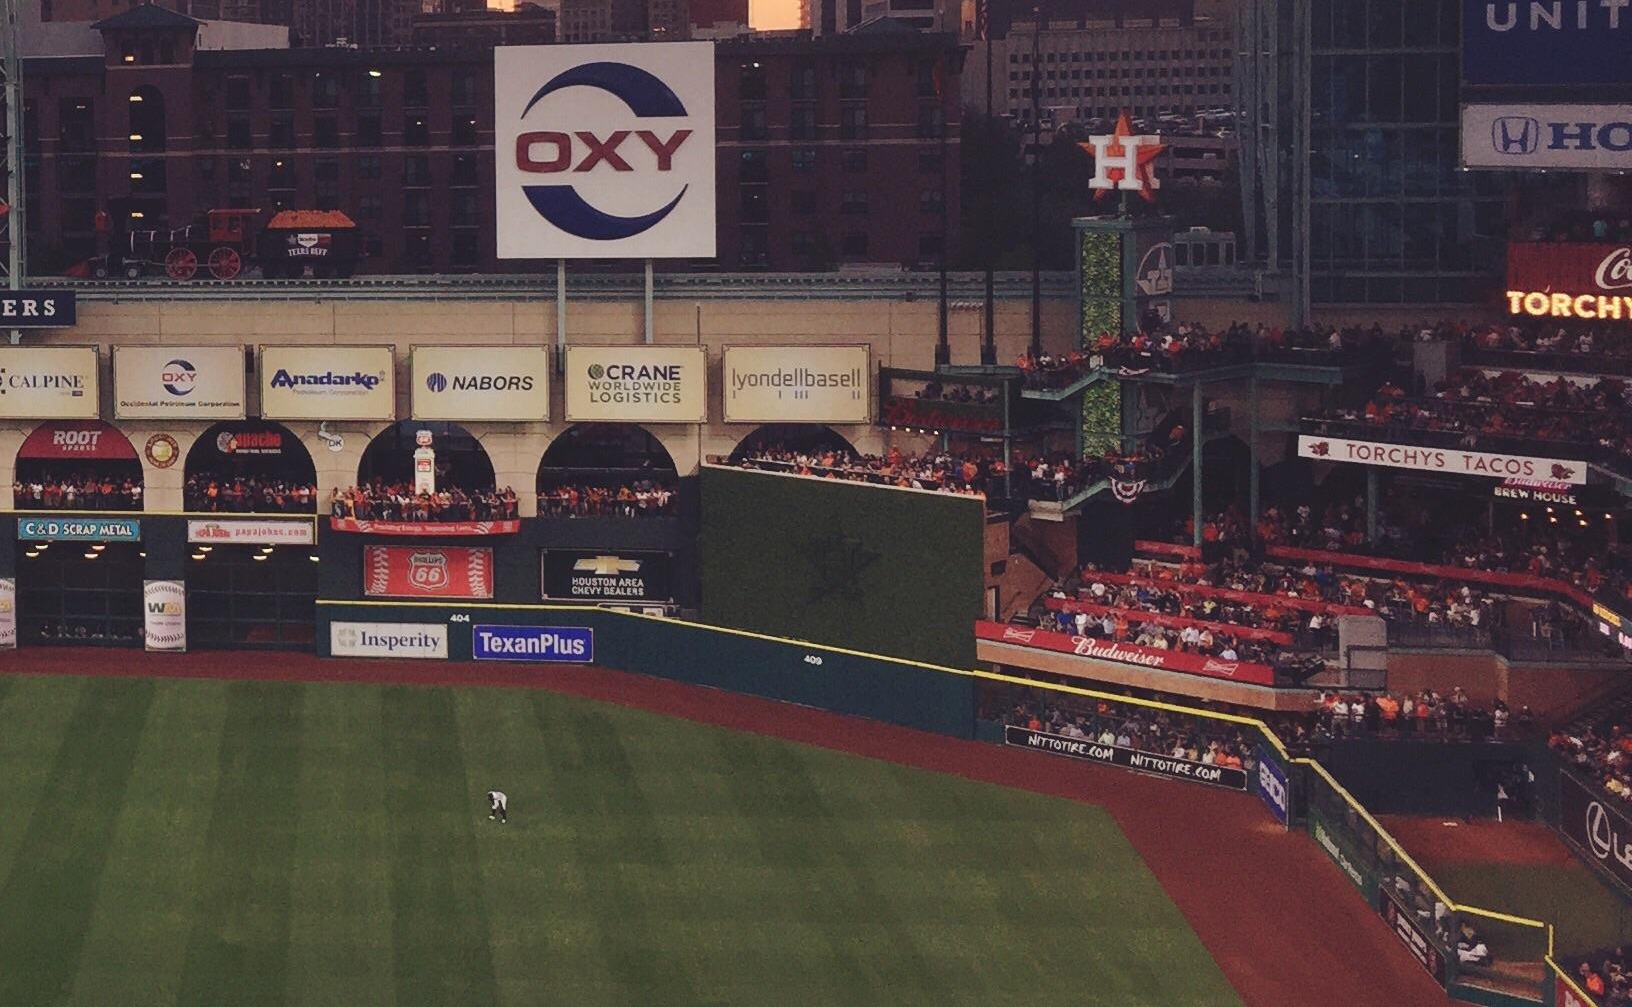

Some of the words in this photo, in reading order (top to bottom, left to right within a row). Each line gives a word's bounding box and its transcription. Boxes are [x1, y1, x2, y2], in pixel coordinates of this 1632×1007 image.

[1486, 0, 1630, 31] UNIT
[516, 130, 694, 173] OXY
[162, 372, 197, 383] OXY
[271, 369, 379, 390] Anadarko
[606, 365, 681, 380] CRANE
[732, 368, 861, 390] lyondellbasell
[9, 374, 84, 389] CALPINE
[452, 375, 534, 390] NABORS
[587, 381, 681, 392] WORLDWIDE
[590, 392, 681, 403] LOGISTICS
[53, 431, 102, 445] ROOT
[1346, 443, 1446, 468] TORCHYS
[1462, 454, 1535, 476] TACOS
[1494, 486, 1529, 499] BREW
[1532, 491, 1577, 505] HOUSE
[63, 525, 97, 535] SCRAP
[99, 525, 133, 536] METAL
[416, 567, 441, 582] 66
[572, 577, 617, 586] HOUSTON
[618, 578, 644, 588] AREA
[571, 586, 602, 595] CHEVY
[603, 587, 644, 596] DEALERS
[450, 613, 470, 622] 404
[361, 631, 440, 652] Insperity
[479, 632, 585, 655] TexanPlus
[1071, 635, 1165, 666] Budweiser
[1028, 734, 1114, 761] NITTOTIRE.COM
[1130, 754, 1221, 782] NITTOTIRE.COM
